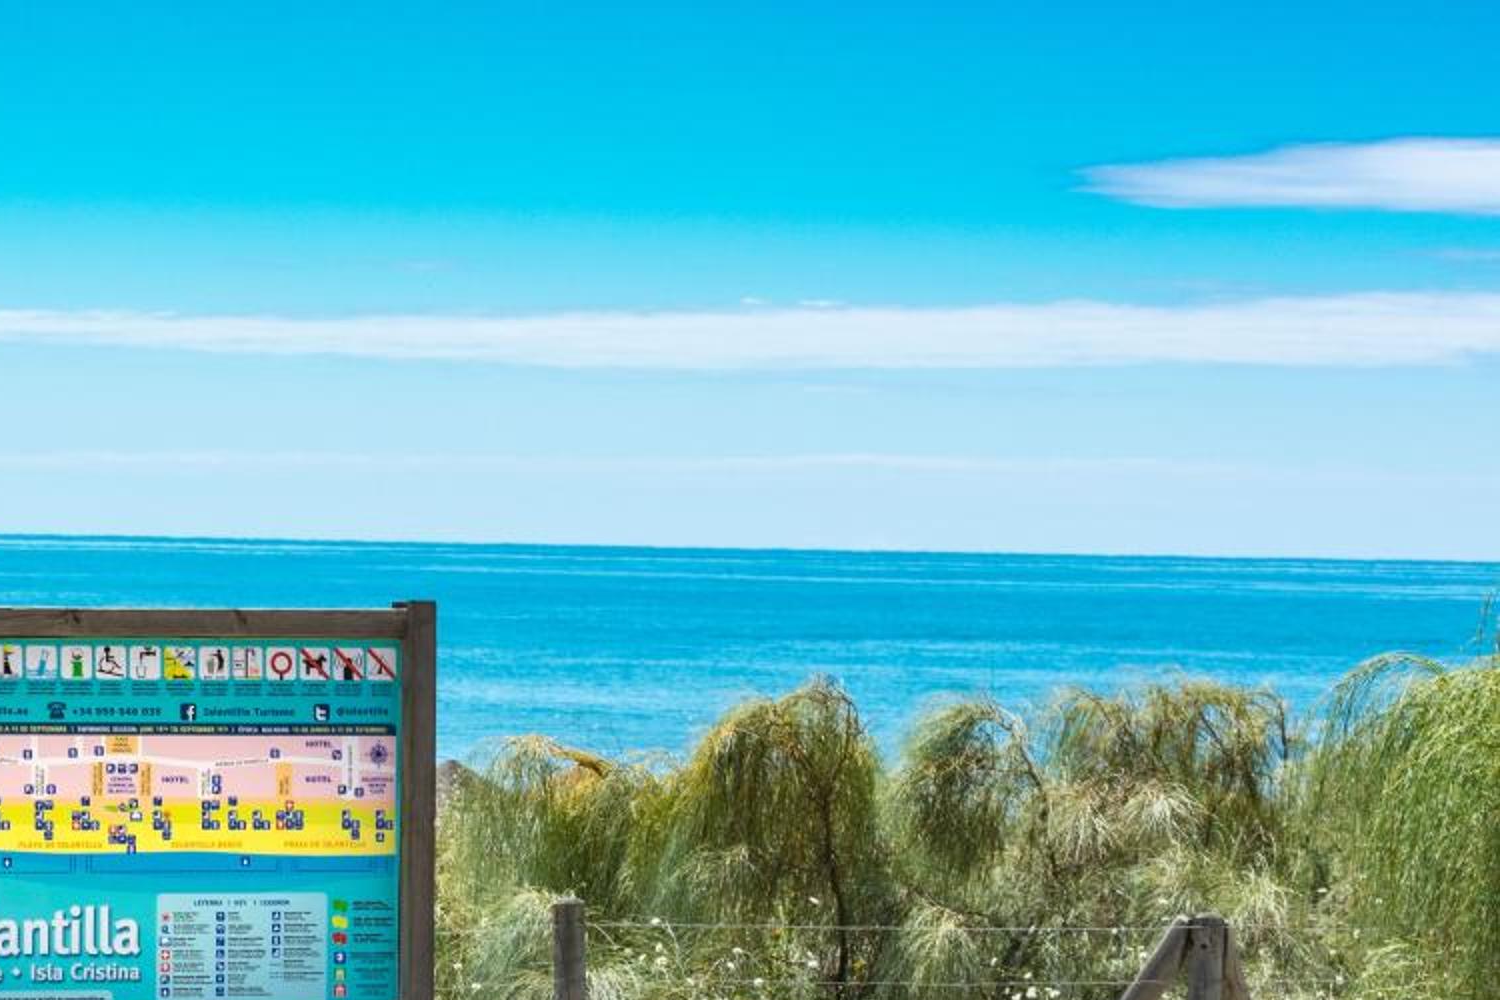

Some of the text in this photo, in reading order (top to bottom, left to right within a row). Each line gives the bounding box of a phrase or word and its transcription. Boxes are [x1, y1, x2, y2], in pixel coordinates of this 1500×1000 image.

[203, 706, 250, 717] Islantilla
[305, 740, 332, 748] HOTEL
[161, 776, 189, 784] HOTEL
[31, 964, 63, 981] Isla
[71, 963, 140, 981] Cristina
